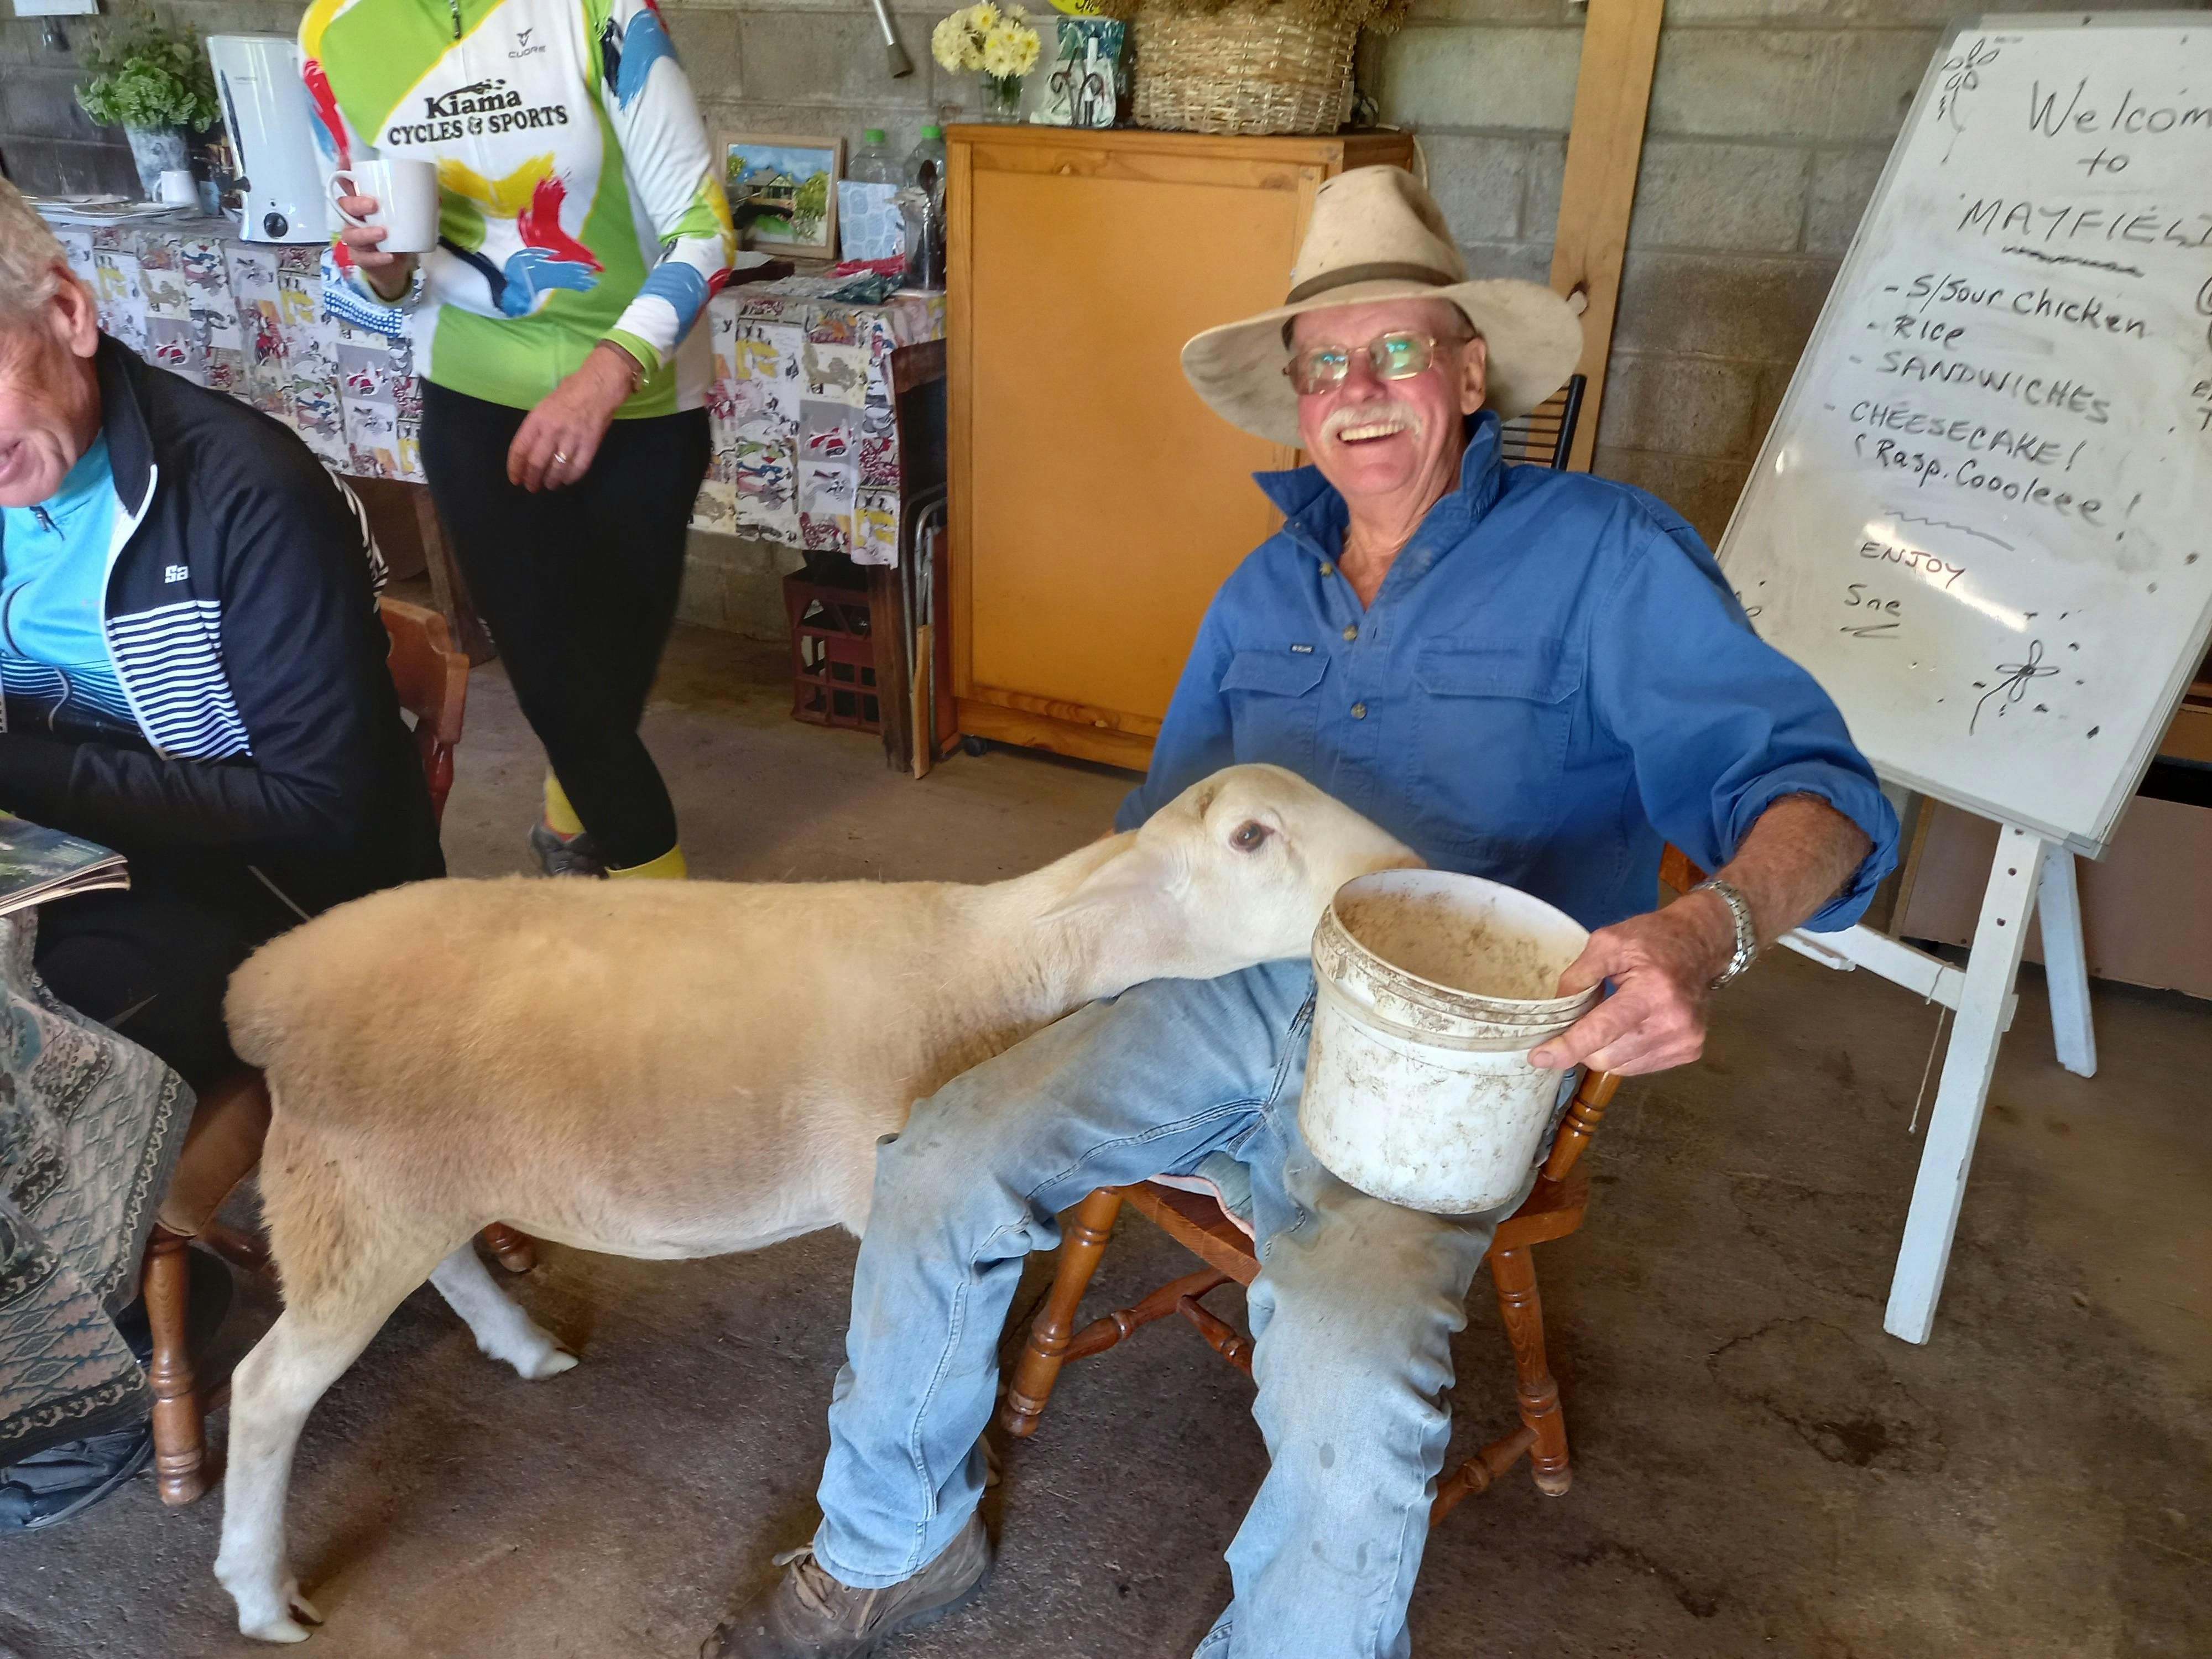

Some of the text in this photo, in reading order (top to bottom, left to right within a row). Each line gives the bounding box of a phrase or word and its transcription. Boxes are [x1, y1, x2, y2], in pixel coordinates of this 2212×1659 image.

[508, 45, 546, 59] CUORE
[424, 90, 522, 119] Kiama
[388, 105, 569, 146] CYCLES & SPORTS
[2077, 146, 2129, 177] to
[2012, 287, 2145, 340] Chicken
[1876, 350, 2111, 424] SANDWICHES
[1860, 541, 1966, 589] ENJOY
